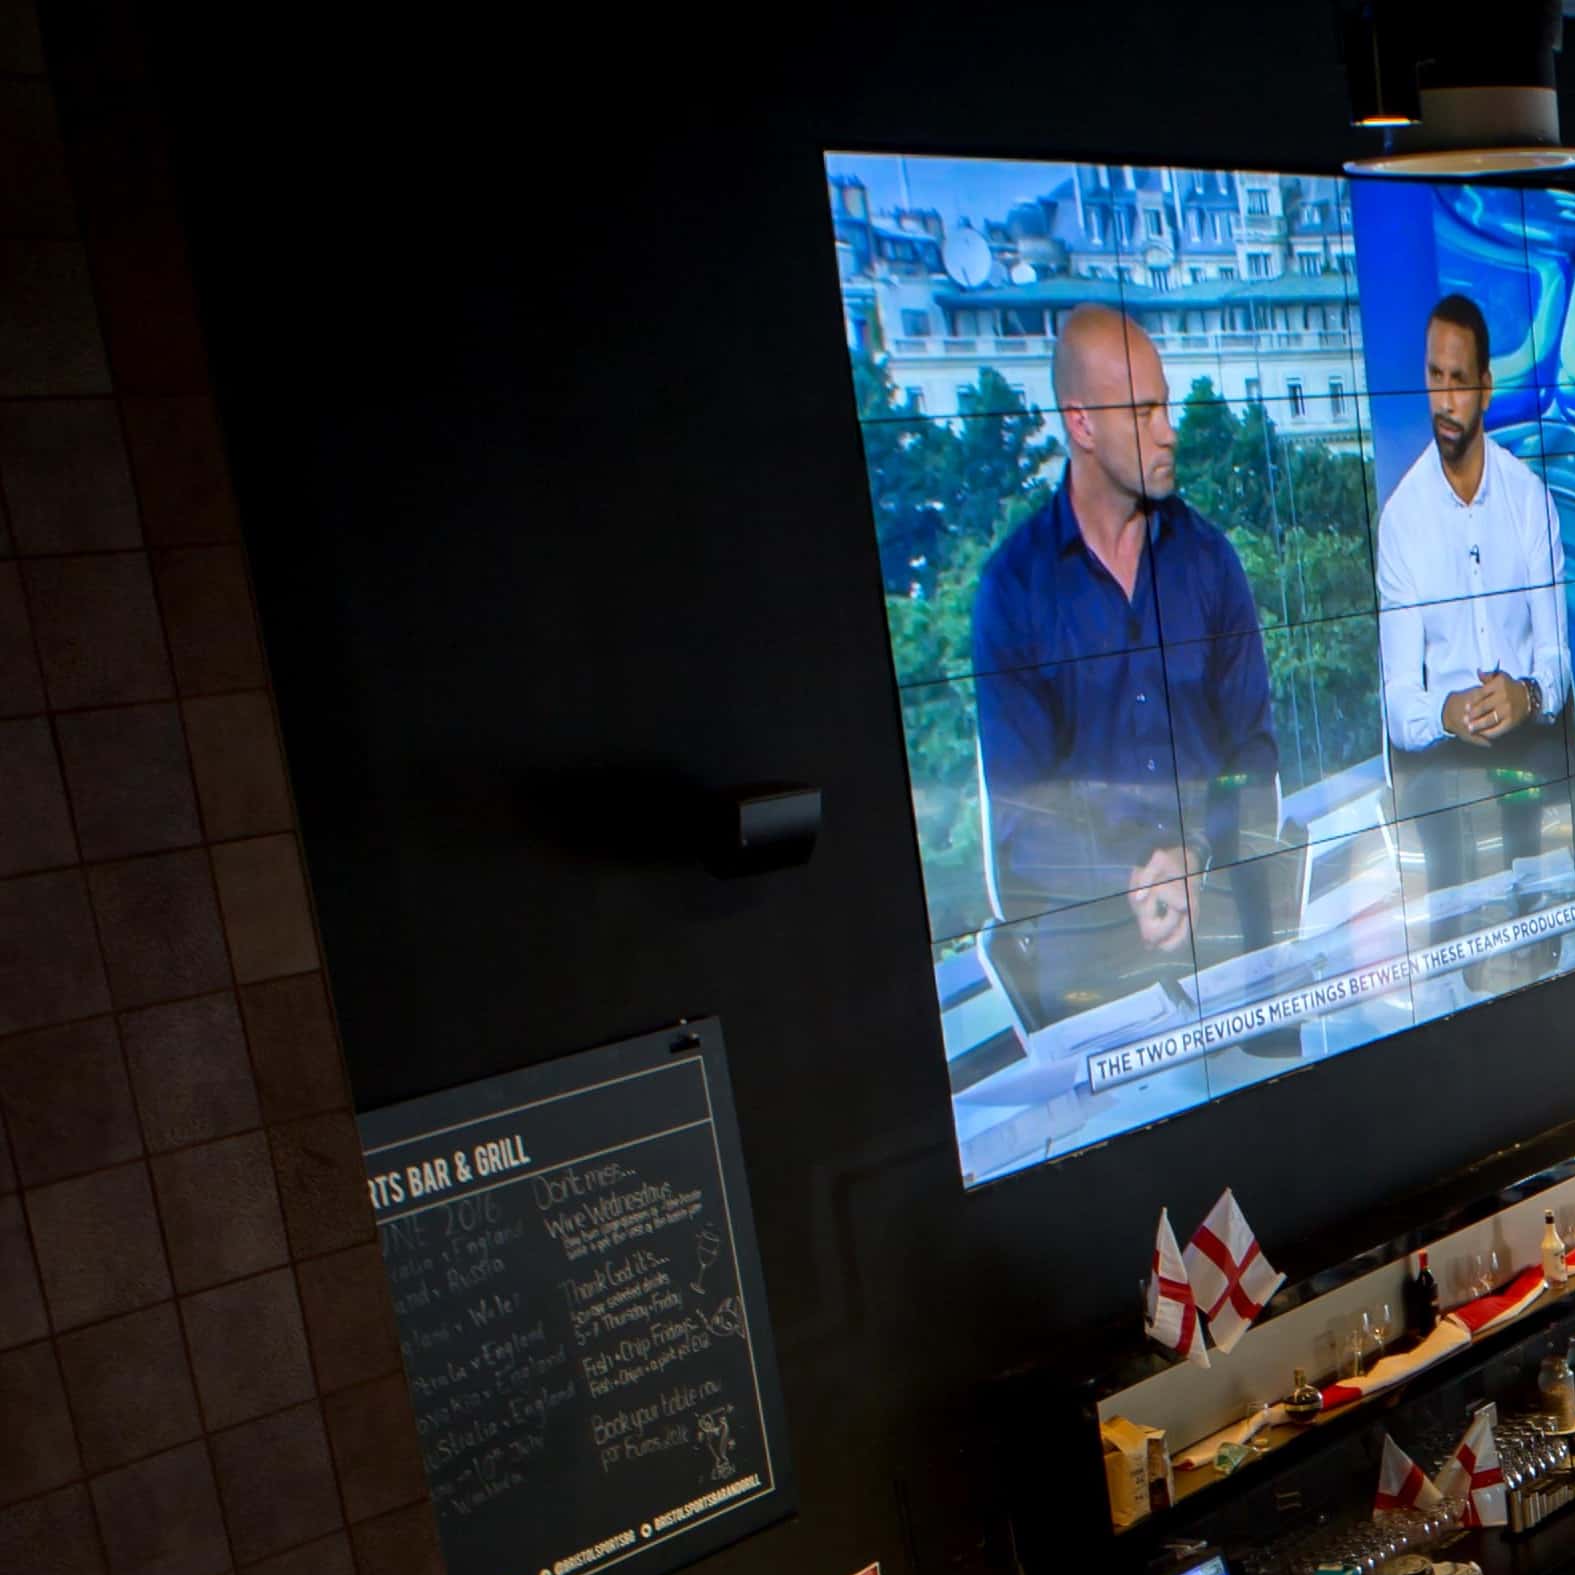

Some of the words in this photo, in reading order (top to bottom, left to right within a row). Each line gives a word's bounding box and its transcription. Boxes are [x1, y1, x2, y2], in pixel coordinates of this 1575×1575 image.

[1096, 1052, 1132, 1080] THE
[1136, 1038, 1177, 1067] TWO
[1182, 1008, 1266, 1051] PREVIOUS
[1268, 981, 1347, 1023] MEETINGS
[1349, 959, 1421, 994] BETWEEN
[1421, 938, 1465, 972] THESE
[1466, 925, 1511, 953] TEAMS
[406, 1157, 452, 1197] BAR
[454, 1151, 474, 1182] &
[474, 1135, 532, 1177] GRILL
